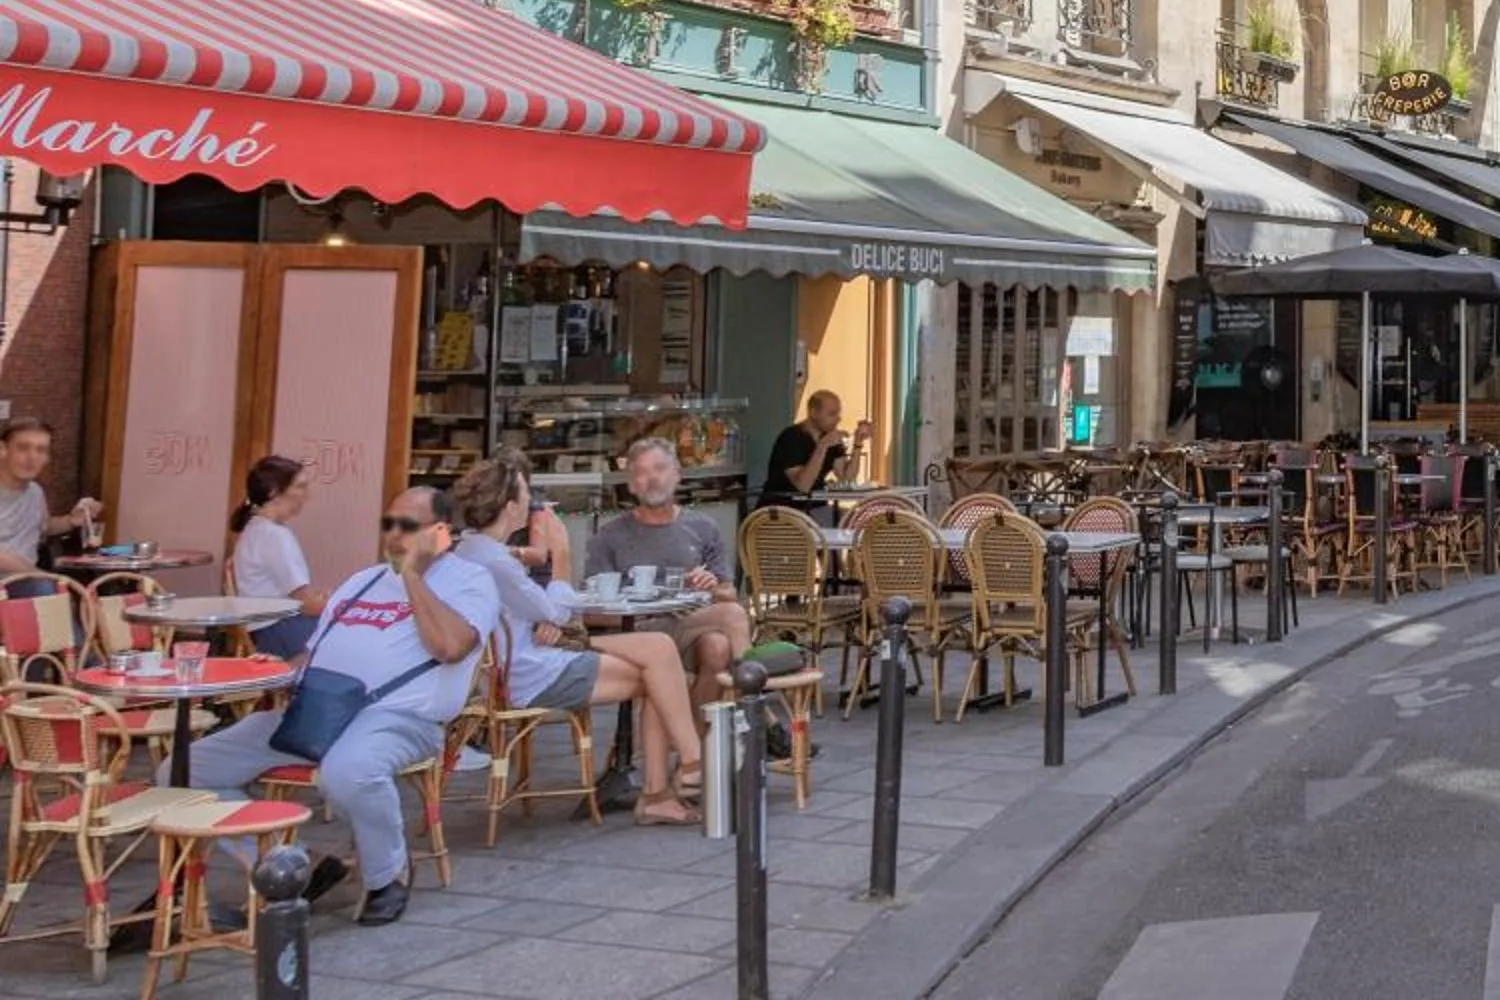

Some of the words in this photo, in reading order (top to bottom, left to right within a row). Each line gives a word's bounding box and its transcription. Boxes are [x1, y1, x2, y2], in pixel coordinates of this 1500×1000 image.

[0, 83, 276, 168] Marché
[851, 243, 905, 272] DELICE
[909, 247, 944, 274] BUCI
